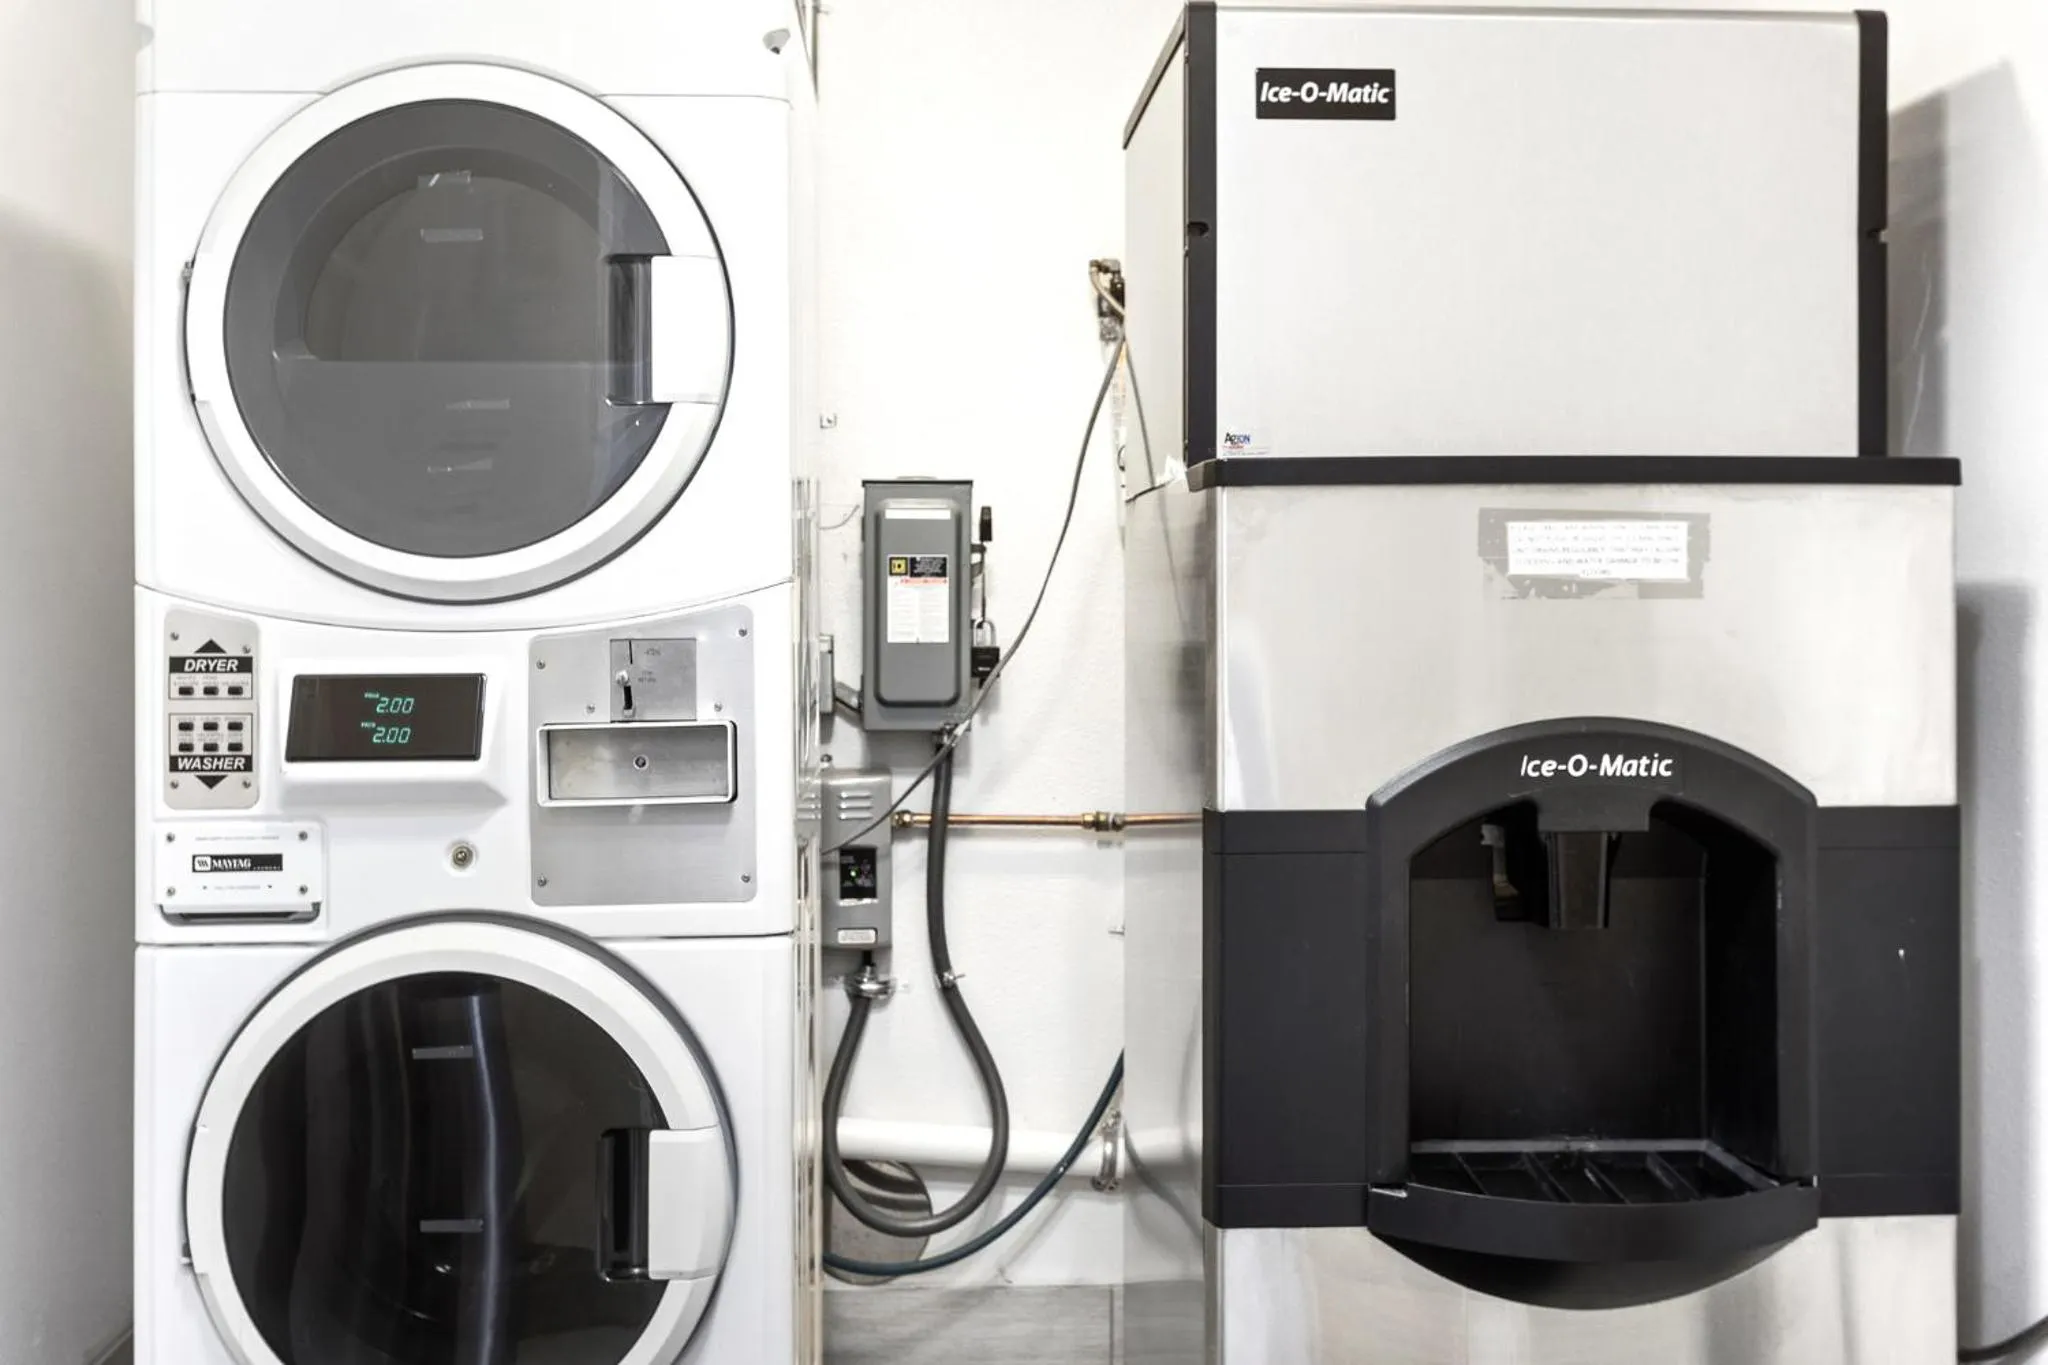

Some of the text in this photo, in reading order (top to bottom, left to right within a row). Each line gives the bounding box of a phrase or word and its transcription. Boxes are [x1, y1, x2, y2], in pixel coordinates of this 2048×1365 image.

[1260, 81, 1390, 103] Ice-O-Matic
[183, 658, 239, 672] DRYER
[376, 697, 415, 714] 2.00
[372, 726, 412, 743] 2.00
[177, 756, 246, 771] WASHER
[1520, 753, 1673, 777] Ice-O-Matic
[212, 858, 252, 870] MAYTAG
